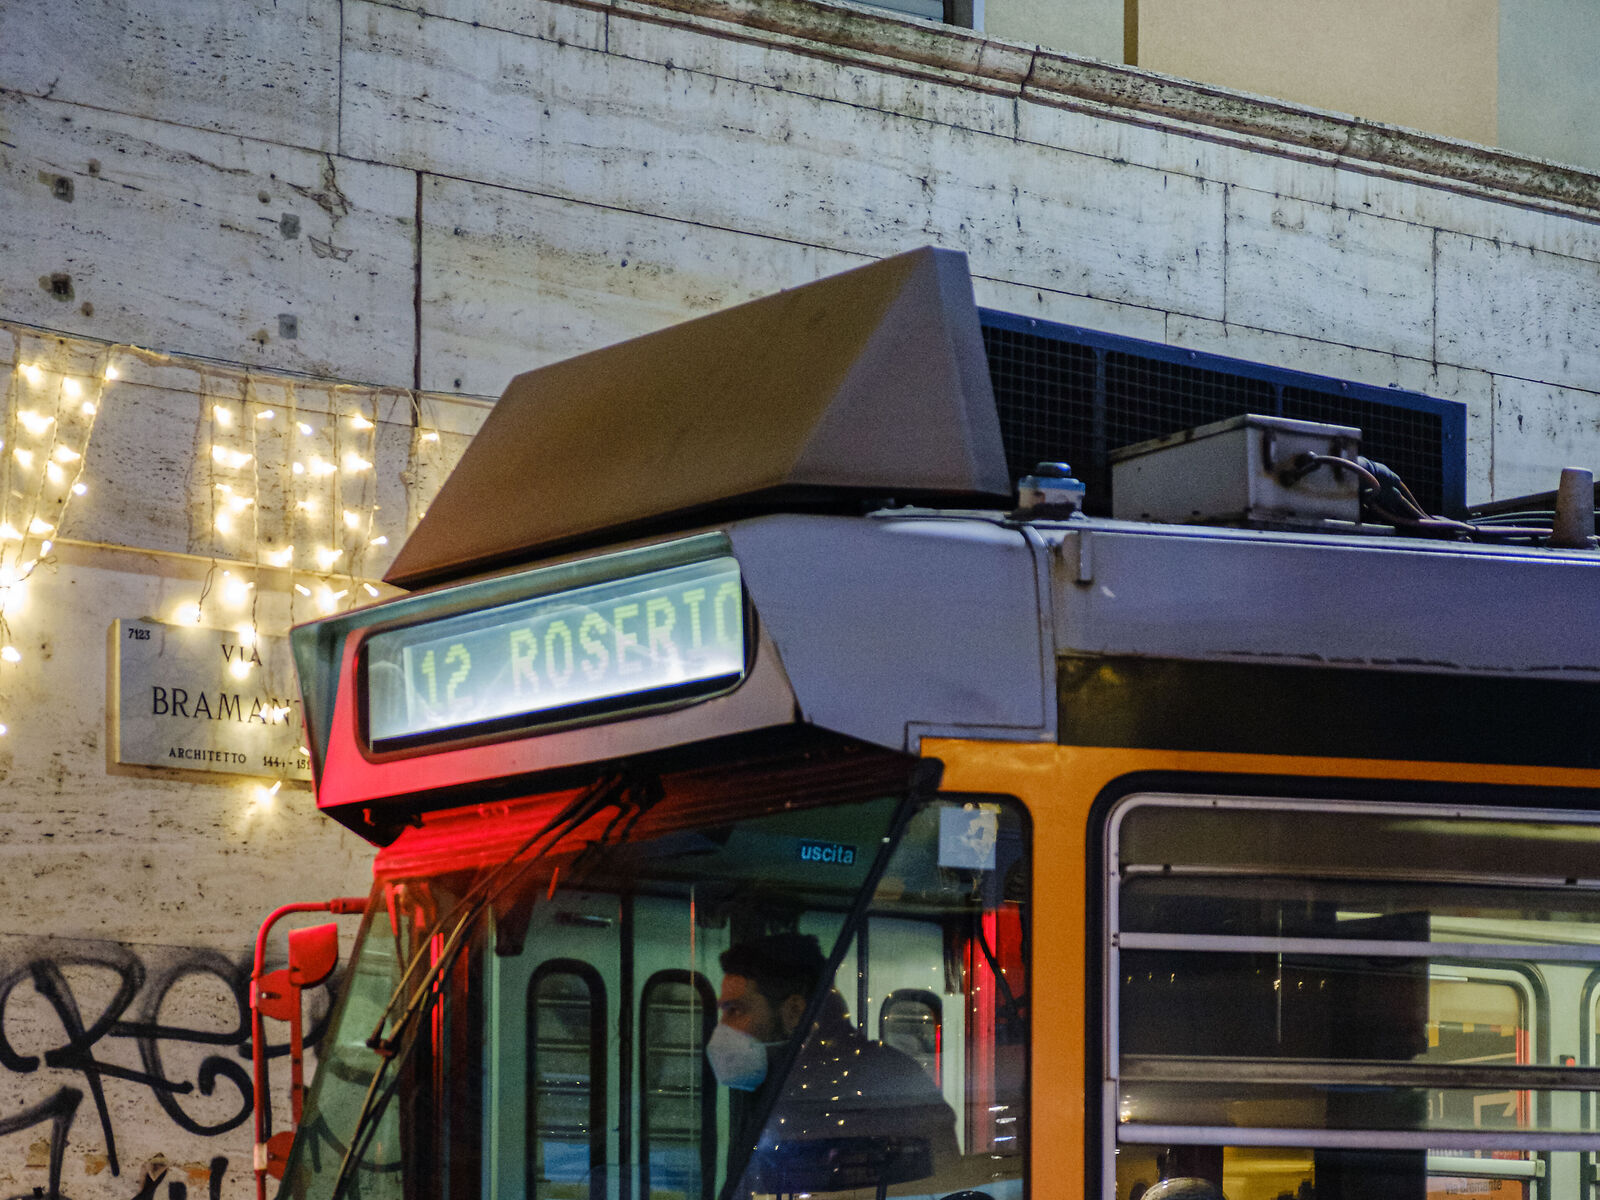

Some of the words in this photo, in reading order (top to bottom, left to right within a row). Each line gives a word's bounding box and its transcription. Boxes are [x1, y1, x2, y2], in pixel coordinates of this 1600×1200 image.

[128, 628, 150, 640] 7123
[221, 644, 263, 667] VIA
[421, 643, 472, 705] 12
[168, 747, 247, 764] ARCHITETTO
[801, 844, 854, 864] uscita
